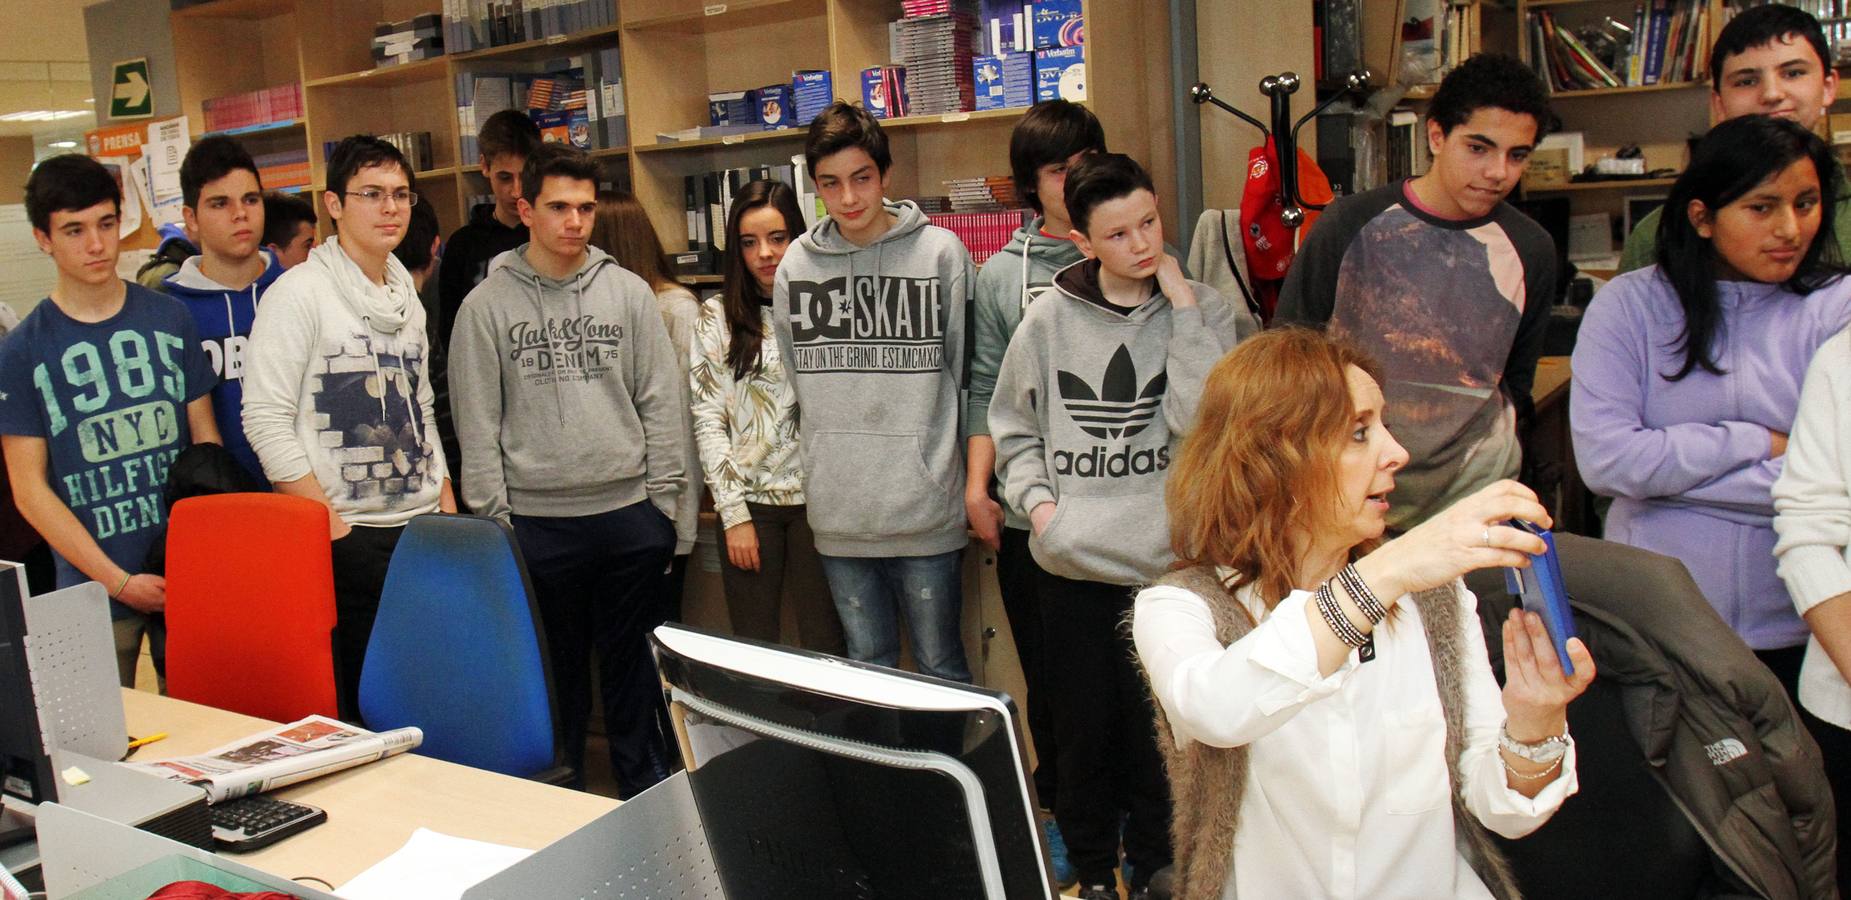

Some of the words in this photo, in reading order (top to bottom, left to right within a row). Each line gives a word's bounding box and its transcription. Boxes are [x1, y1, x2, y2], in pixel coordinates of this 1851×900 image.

[1046, 48, 1075, 57] Verbatim
[103, 131, 140, 152] PRENSA
[856, 277, 943, 338] SKATE
[537, 346, 600, 371] DENIM
[603, 349, 618, 359] 75
[795, 347, 815, 368] STAY
[816, 347, 826, 368] ON
[828, 346, 845, 368] THE
[848, 346, 880, 368] GRIND.
[33, 329, 186, 437] 1985
[91, 406, 169, 456] NYC
[1054, 445, 1169, 478] adidas
